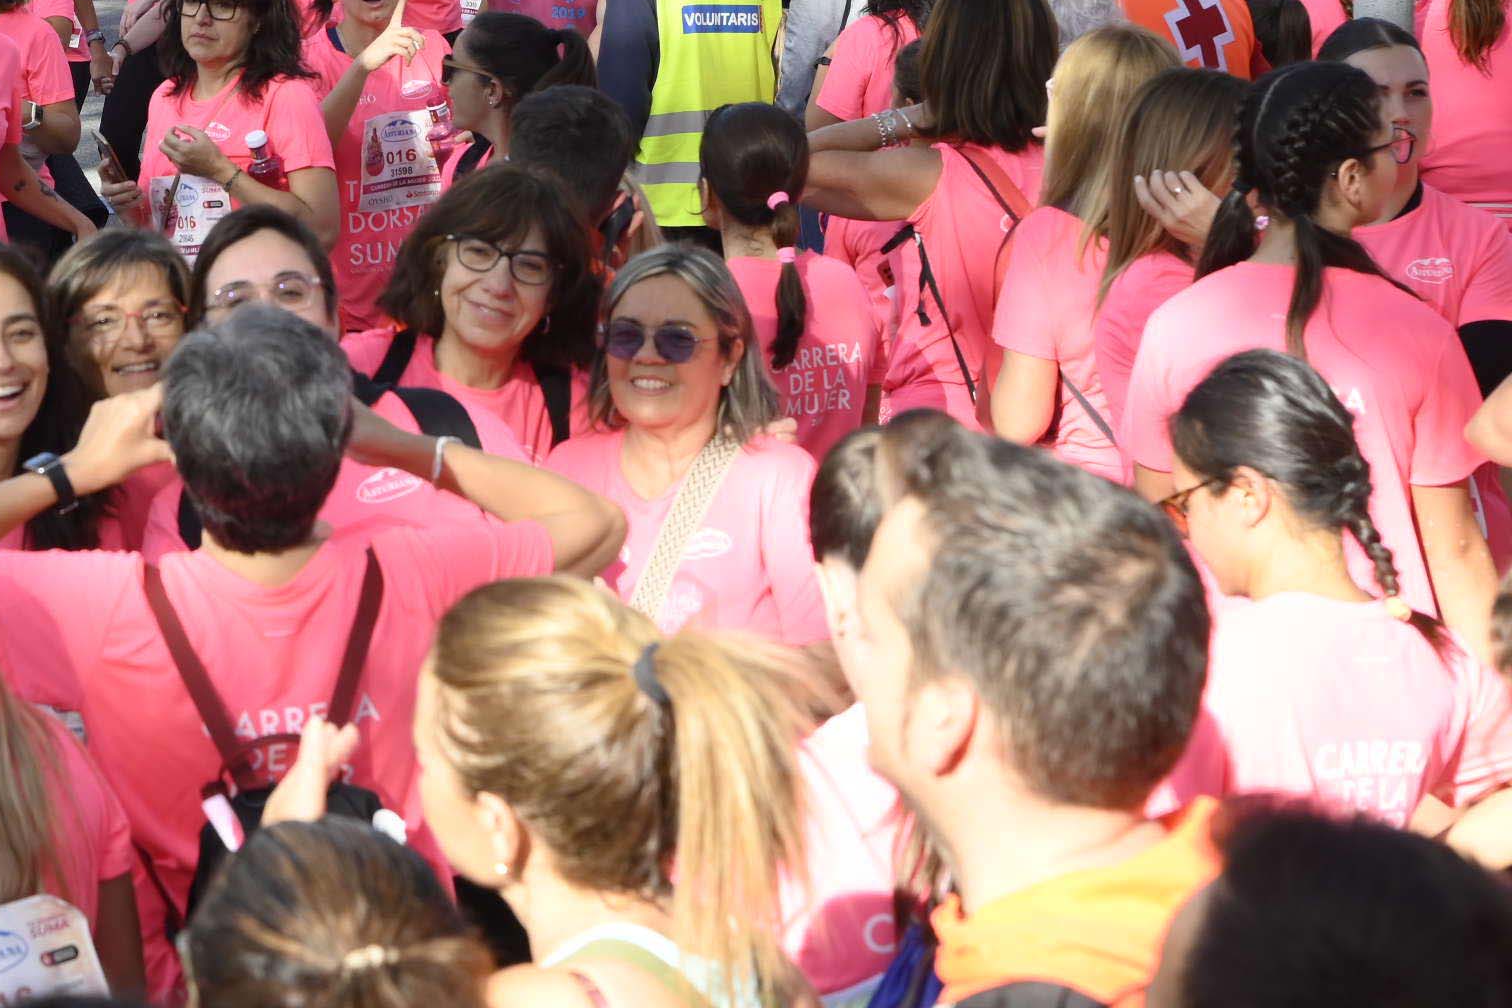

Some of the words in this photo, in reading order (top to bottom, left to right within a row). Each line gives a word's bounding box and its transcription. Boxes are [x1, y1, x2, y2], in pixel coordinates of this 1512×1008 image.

[683, 13, 759, 28] VOLUNTARIS
[386, 148, 417, 165] 016
[390, 166, 413, 178] 31598
[346, 180, 360, 201] T
[177, 215, 197, 230] 016
[789, 372, 816, 394] DE
[821, 371, 847, 391] LA
[785, 388, 851, 416] MUJER
[1314, 740, 1428, 779] CARRER
